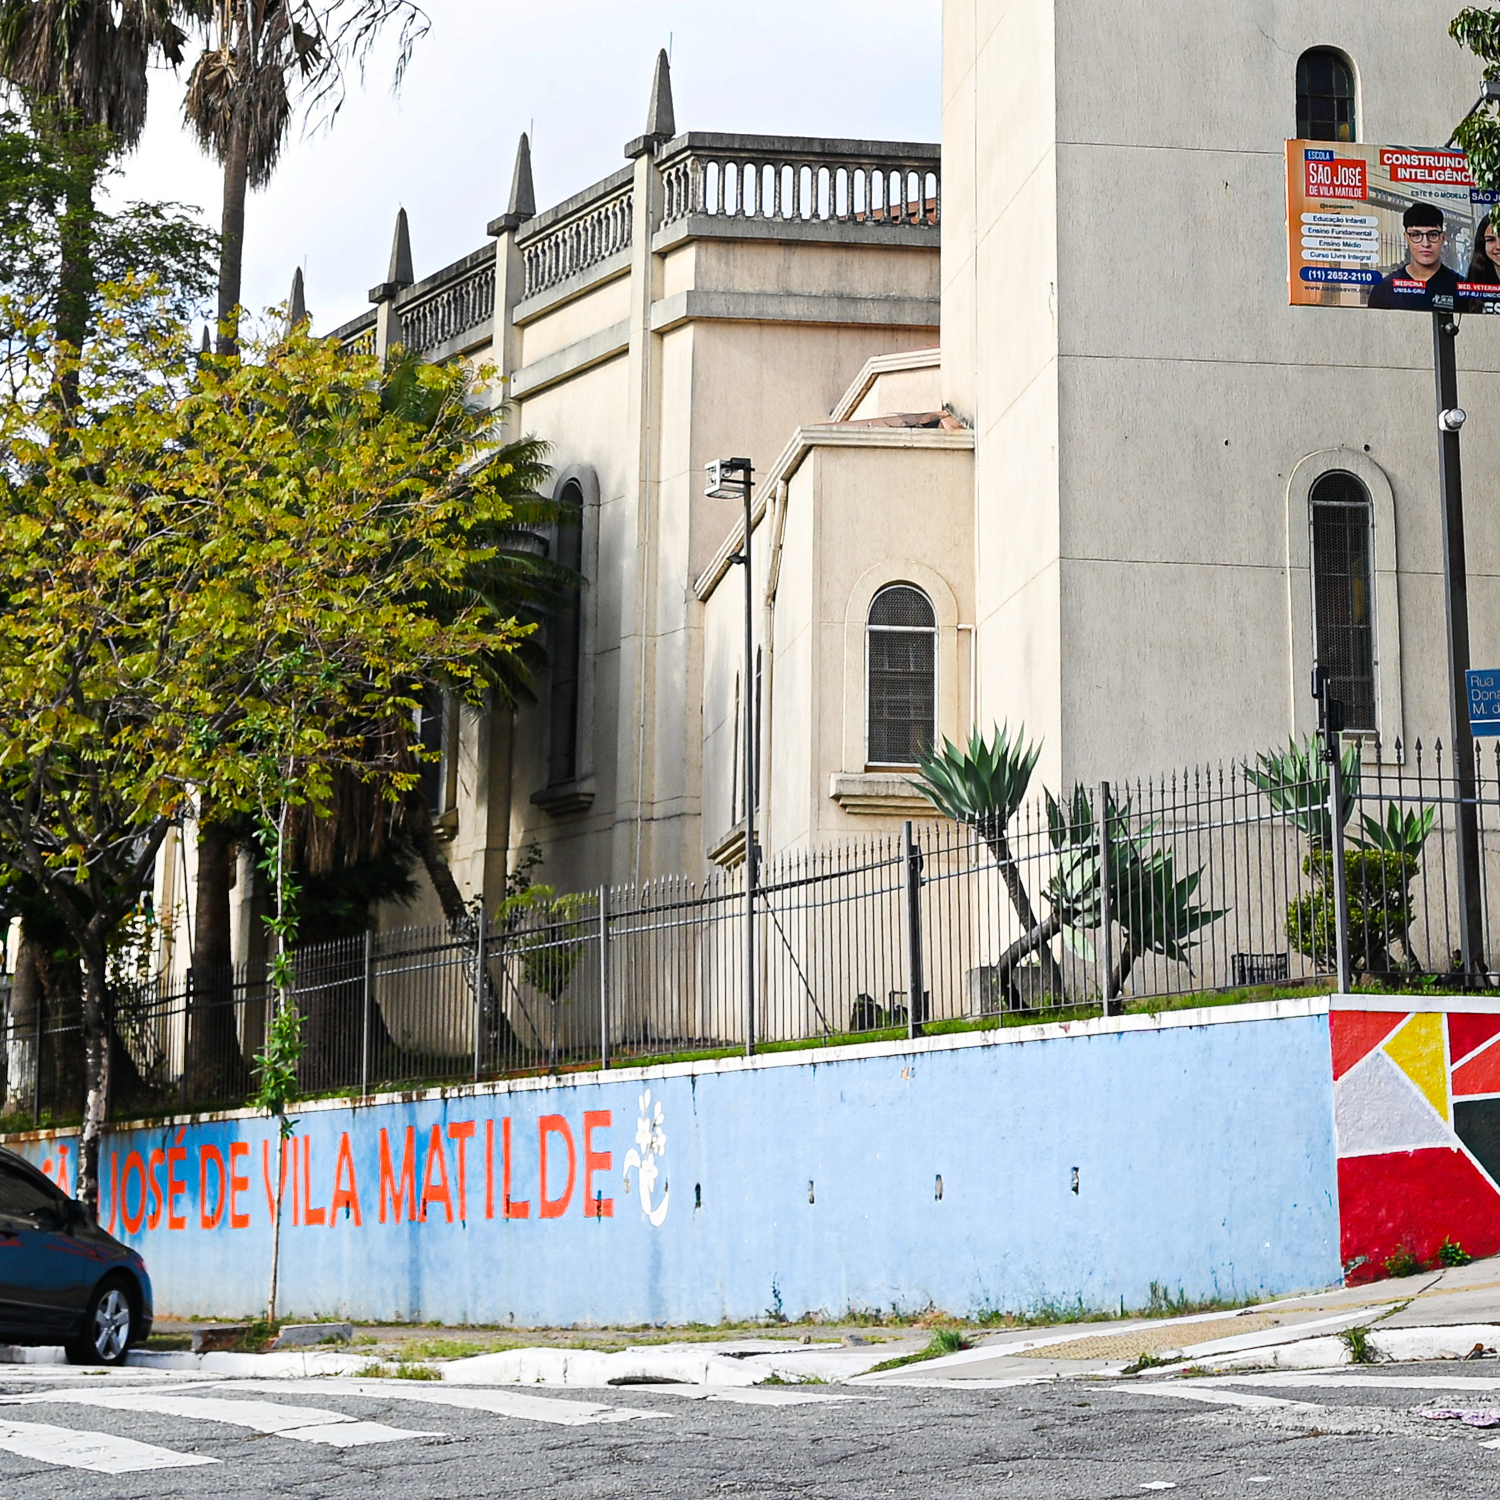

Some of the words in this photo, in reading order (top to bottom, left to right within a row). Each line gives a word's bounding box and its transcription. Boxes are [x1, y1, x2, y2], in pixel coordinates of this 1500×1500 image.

[1308, 151, 1330, 160] ESCOLA
[1309, 163, 1331, 184] SÃO
[1333, 165, 1362, 186] JOSÉ
[1309, 185, 1318, 195] DE
[1320, 186, 1334, 196] VILA
[1335, 186, 1362, 198] MATILDE
[1440, 191, 1468, 200] MODELO
[1313, 215, 1344, 224] Educação
[1308, 227, 1330, 235] Ensino
[1331, 228, 1372, 236] Fundamental
[1342, 240, 1361, 248] Médio
[1310, 251, 1329, 259] Curso
[1347, 253, 1371, 261] Integral
[1308, 269, 1325, 281] (11)
[1327, 271, 1372, 282] 2652-2110
[1470, 675, 1494, 687] Rua
[1473, 702, 1488, 715] M.
[107, 1125, 188, 1235] JOSÉ
[200, 1142, 250, 1230] DE
[262, 1131, 363, 1228] VILA
[379, 1109, 614, 1225] MATILDE
